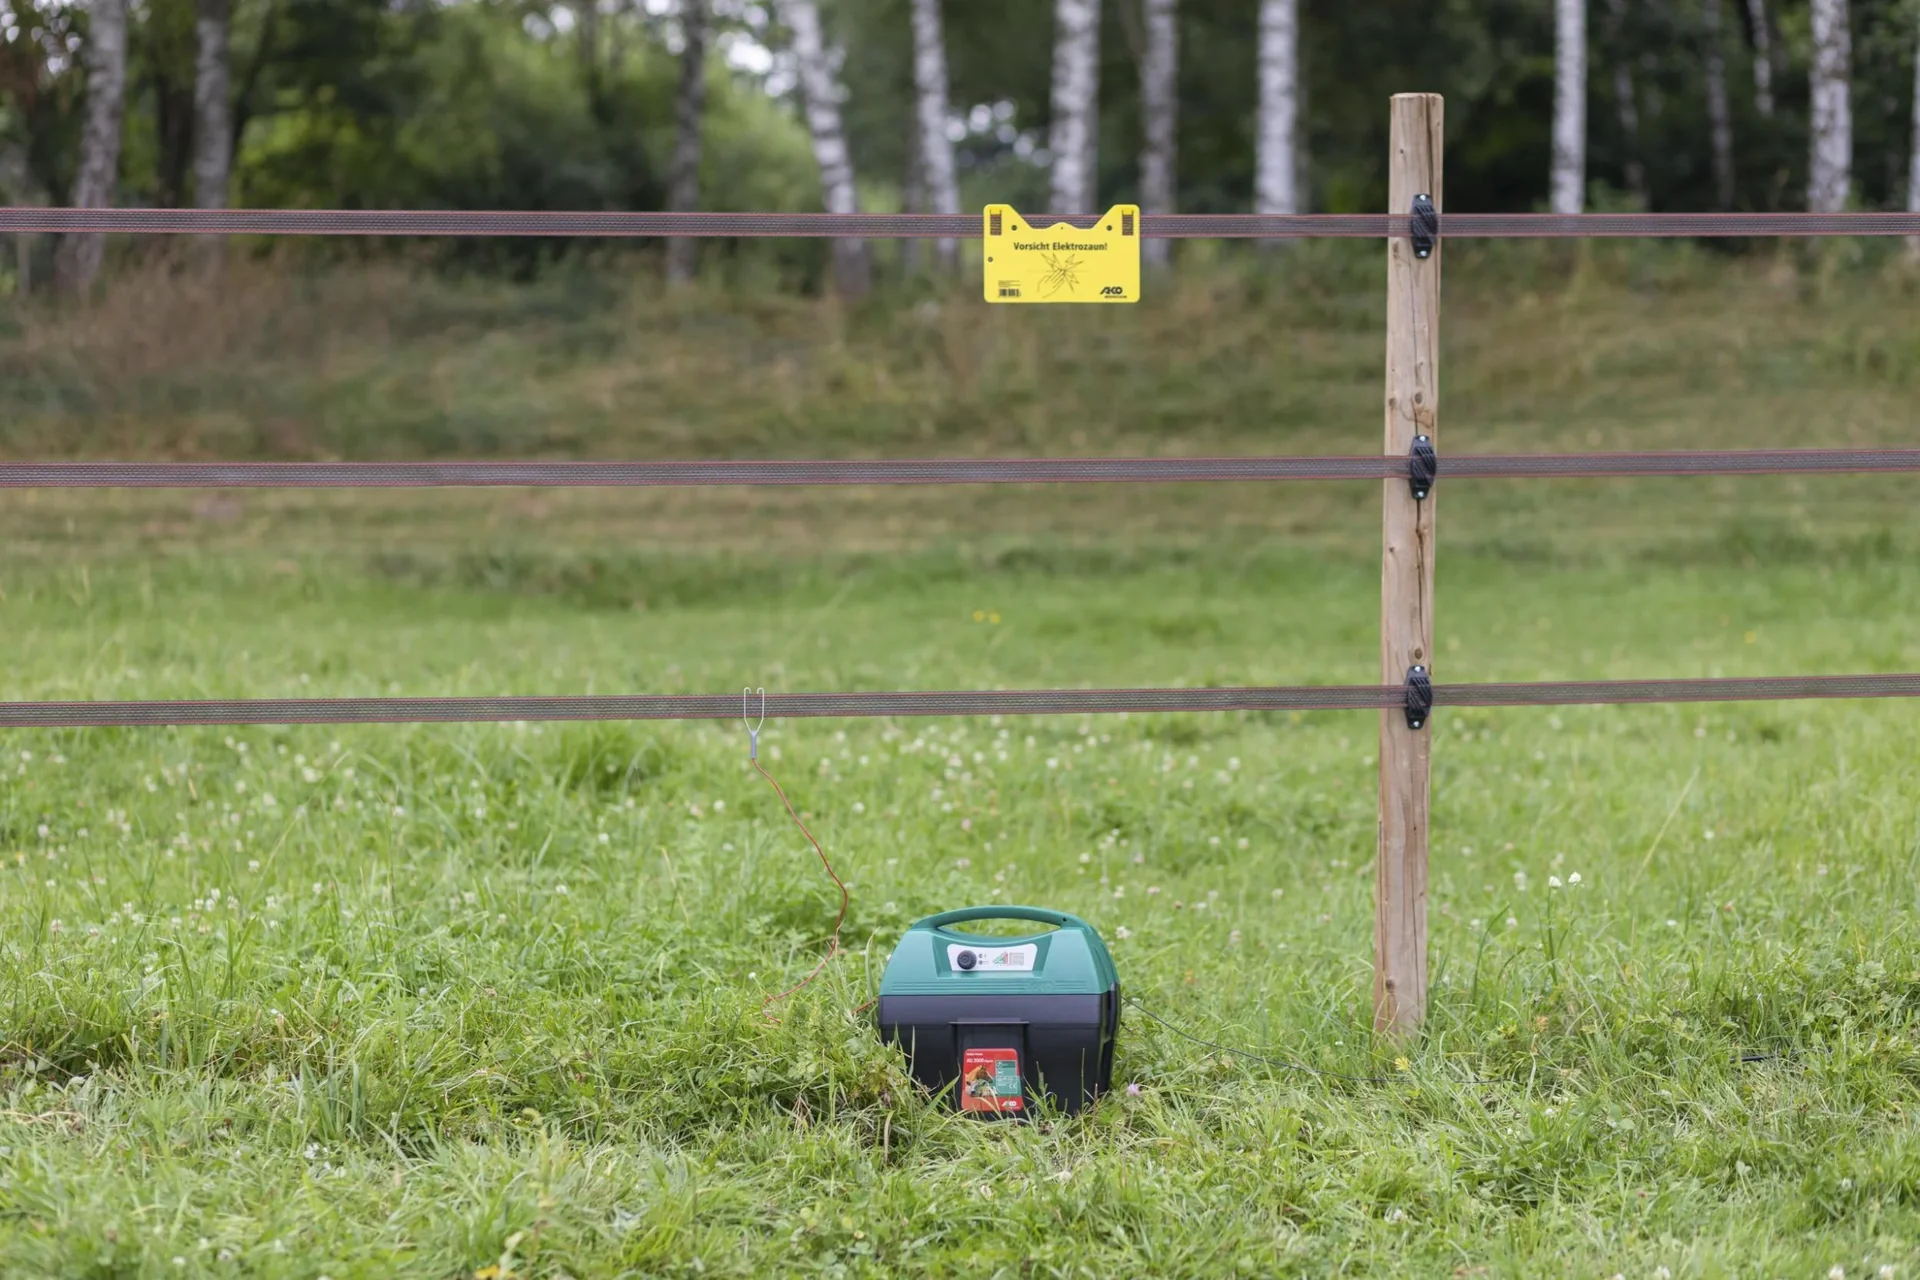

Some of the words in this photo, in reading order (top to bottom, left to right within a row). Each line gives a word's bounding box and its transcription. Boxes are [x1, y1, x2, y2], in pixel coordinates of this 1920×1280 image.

[1013, 242, 1050, 251] Vorsicht
[1052, 242, 1107, 251] Elektrozaun!
[1100, 286, 1123, 295] AKO
